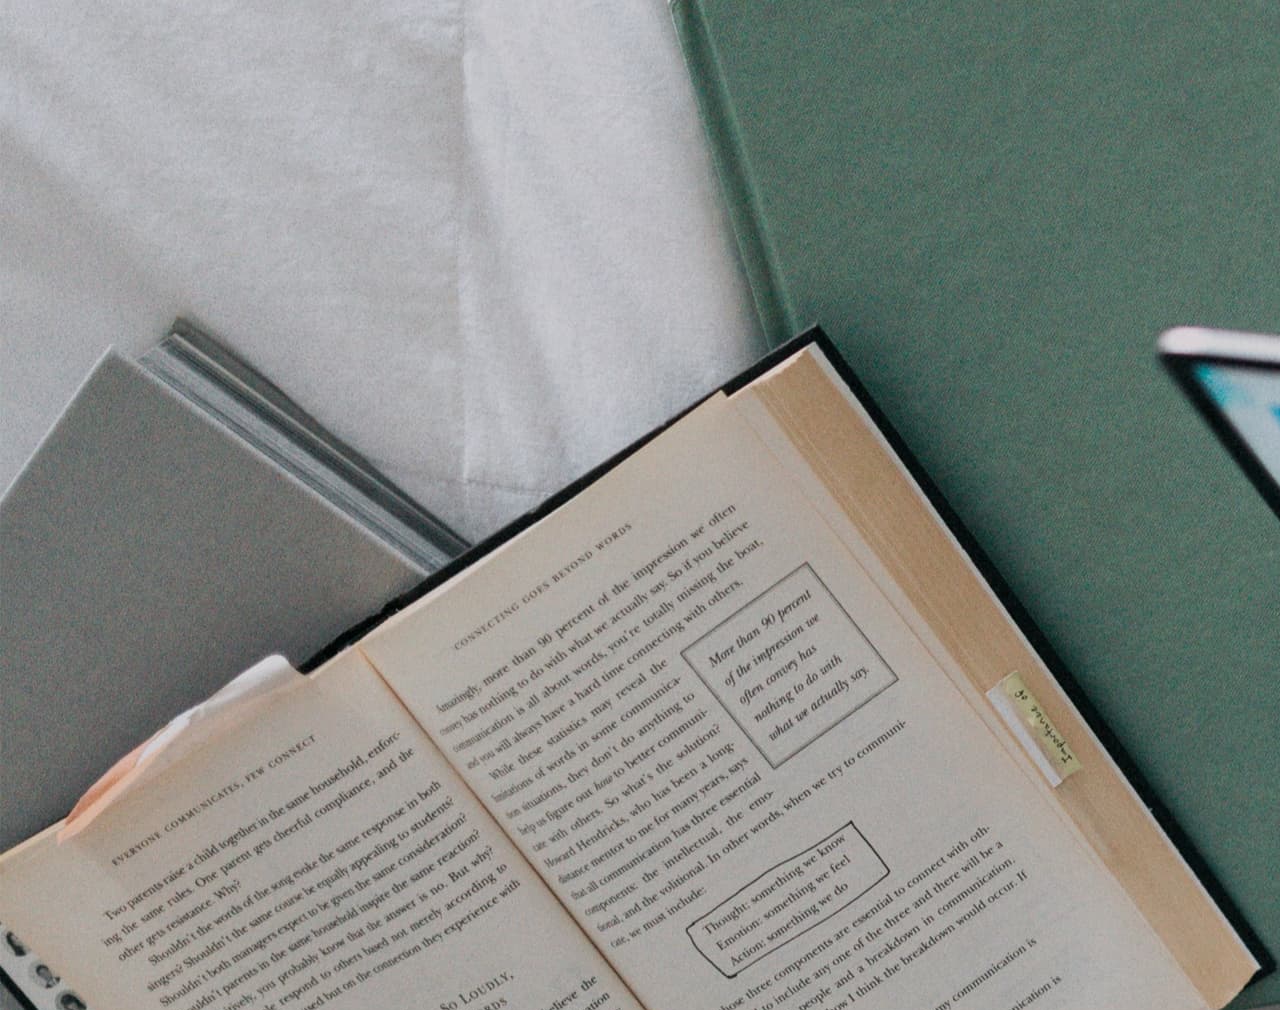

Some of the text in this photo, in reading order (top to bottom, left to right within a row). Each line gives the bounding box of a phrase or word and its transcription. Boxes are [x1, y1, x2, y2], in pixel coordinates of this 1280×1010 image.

[453, 523, 632, 650] CONNECTING GOES BEYOND WORDS
[708, 589, 812, 668] More than 90 percent
[724, 613, 819, 686] of the impression we
[739, 645, 817, 705] often convey has
[753, 654, 843, 722] nothing to do with
[768, 666, 869, 741] what we actually say.
[111, 734, 315, 866] EVERYONE COMMUNICATES, FEW CONNECT
[702, 835, 845, 935] Thought: something we know
[715, 854, 851, 951] Emotion: something we feel
[730, 883, 848, 967] Action: something we do
[458, 971, 514, 1005] LOUDLY,
